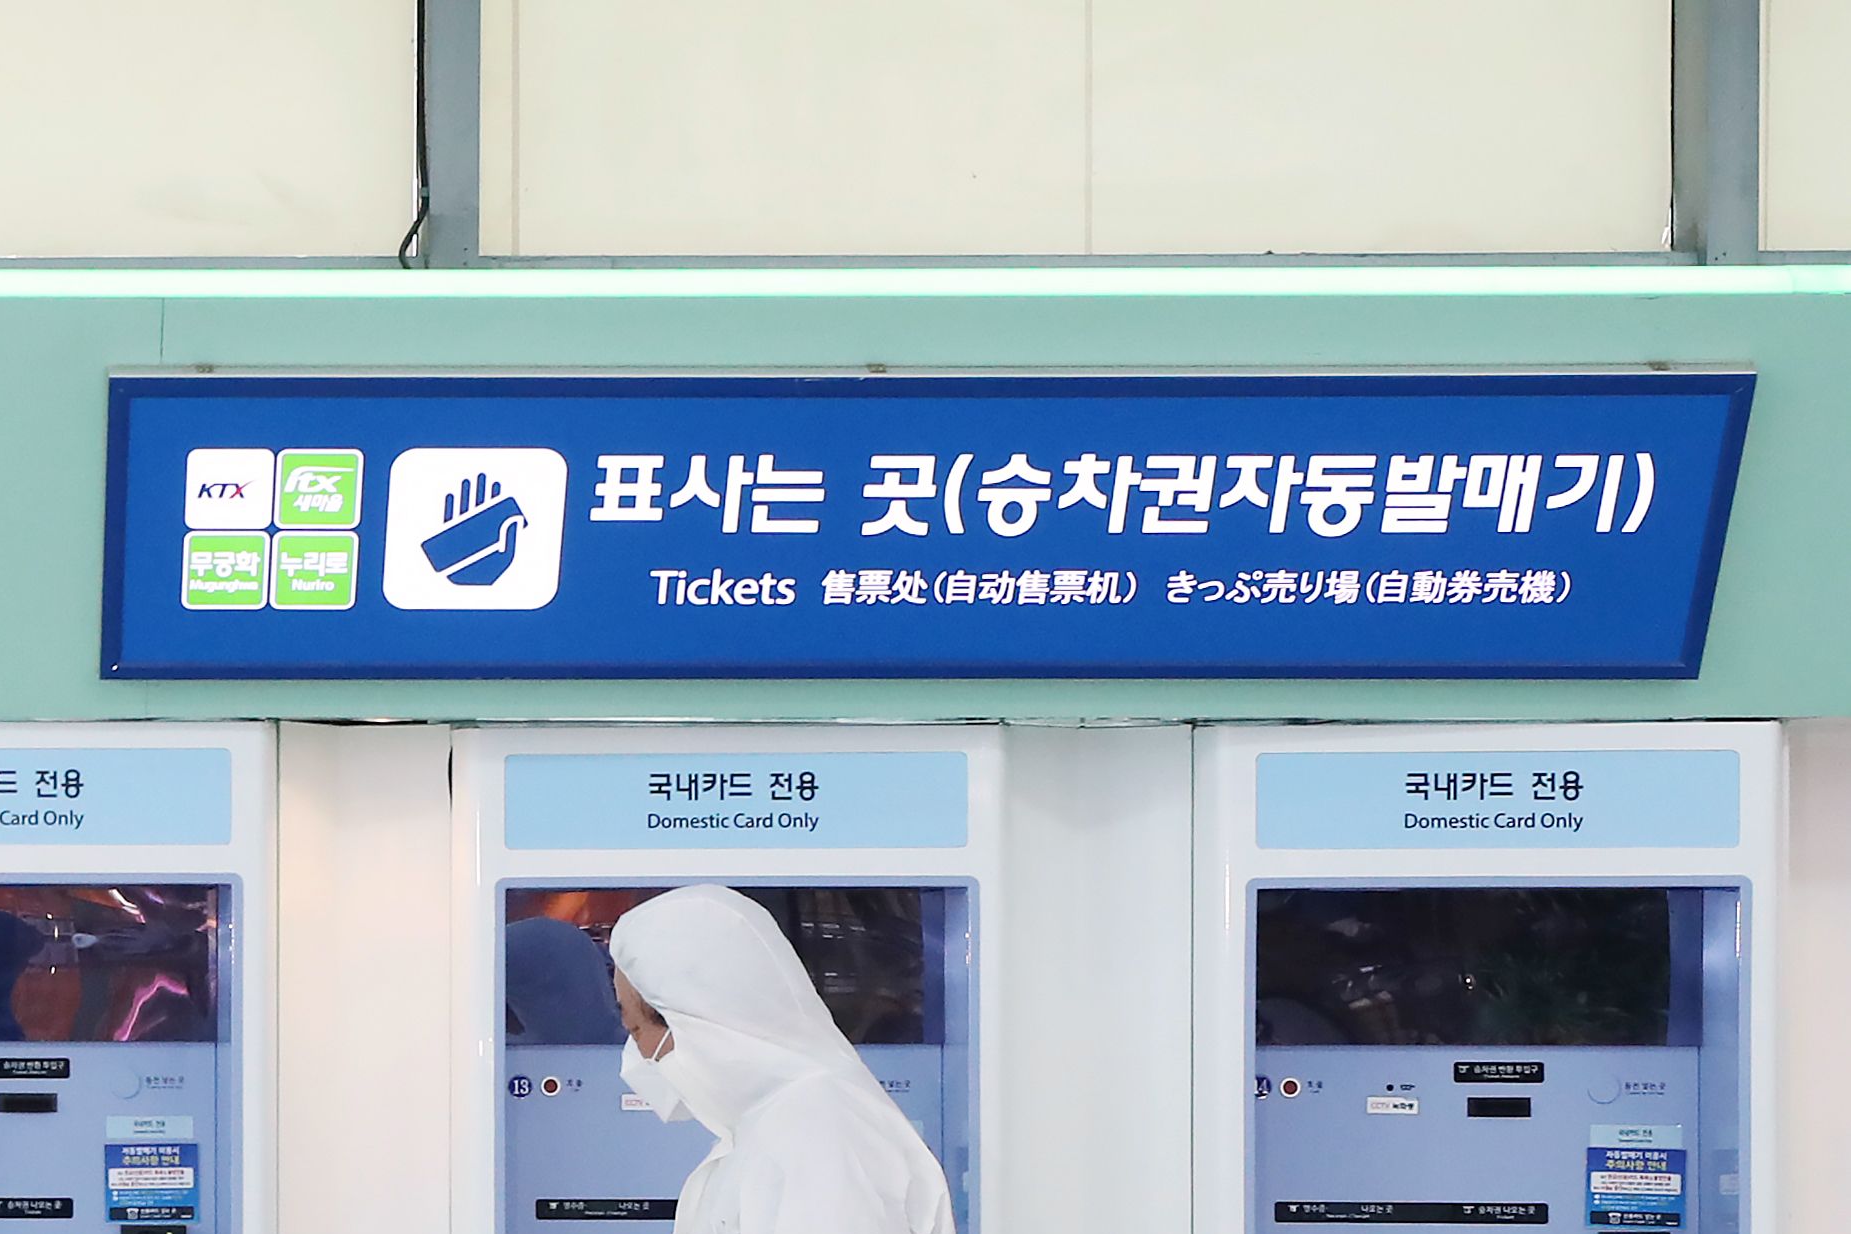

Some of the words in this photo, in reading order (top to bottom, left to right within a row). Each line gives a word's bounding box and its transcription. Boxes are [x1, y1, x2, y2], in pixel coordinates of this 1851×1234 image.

[197, 480, 255, 499] KTX
[589, 453, 827, 535] 표사는
[860, 452, 1656, 539] 곳(승차권자동발매기)
[293, 493, 344, 513] 새마을
[189, 550, 261, 578] 무궁화
[279, 551, 349, 577] 누리로
[290, 578, 335, 592] Nuriro
[649, 568, 797, 606] Tickets
[34, 769, 84, 799] 전용
[648, 771, 752, 801] 국내카드
[769, 771, 820, 801] 전용
[1405, 771, 1513, 801] 국내카드
[1531, 771, 1584, 801] 전용
[0, 809, 39, 827] Card
[43, 810, 84, 830] Only
[647, 812, 729, 829] Domestic
[733, 812, 773, 829] Card
[778, 812, 820, 832] Only
[1404, 812, 1490, 829] Domestic
[1494, 812, 1536, 829] Card
[1540, 812, 1584, 832] Only
[513, 1079, 530, 1095] 13
[1606, 1160, 1645, 1170] 주의사항
[1647, 1160, 1667, 1170] 안내
